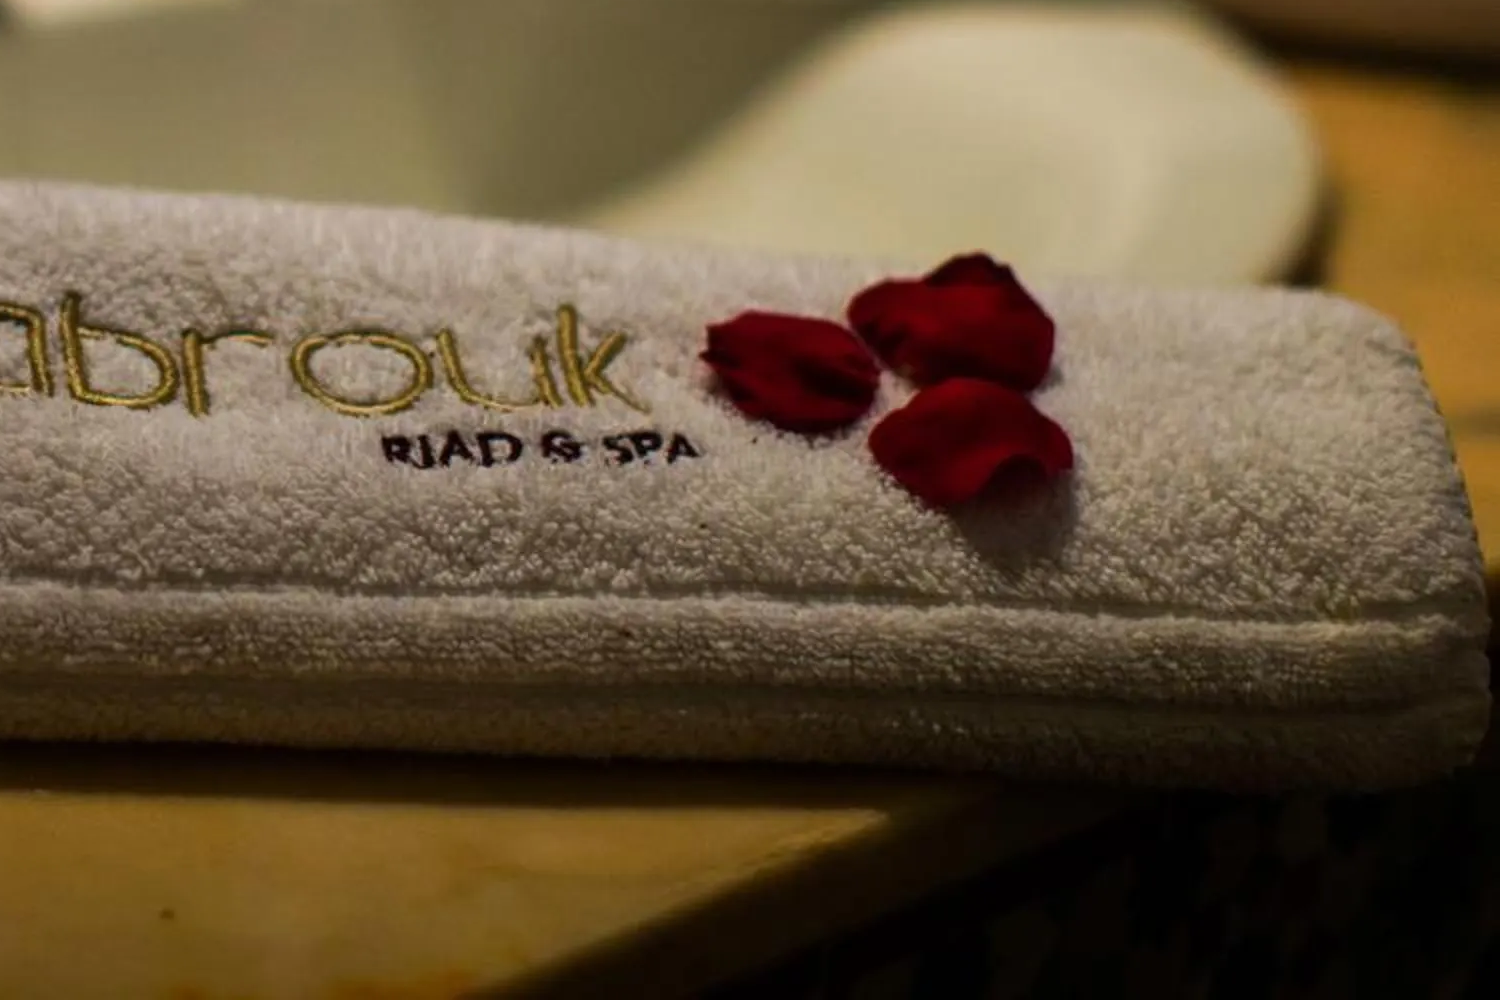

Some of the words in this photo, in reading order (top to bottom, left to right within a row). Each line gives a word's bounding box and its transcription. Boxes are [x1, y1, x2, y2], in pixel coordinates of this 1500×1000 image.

[381, 430, 524, 469] RIAD
[540, 430, 587, 463] &
[603, 432, 701, 467] SPA
